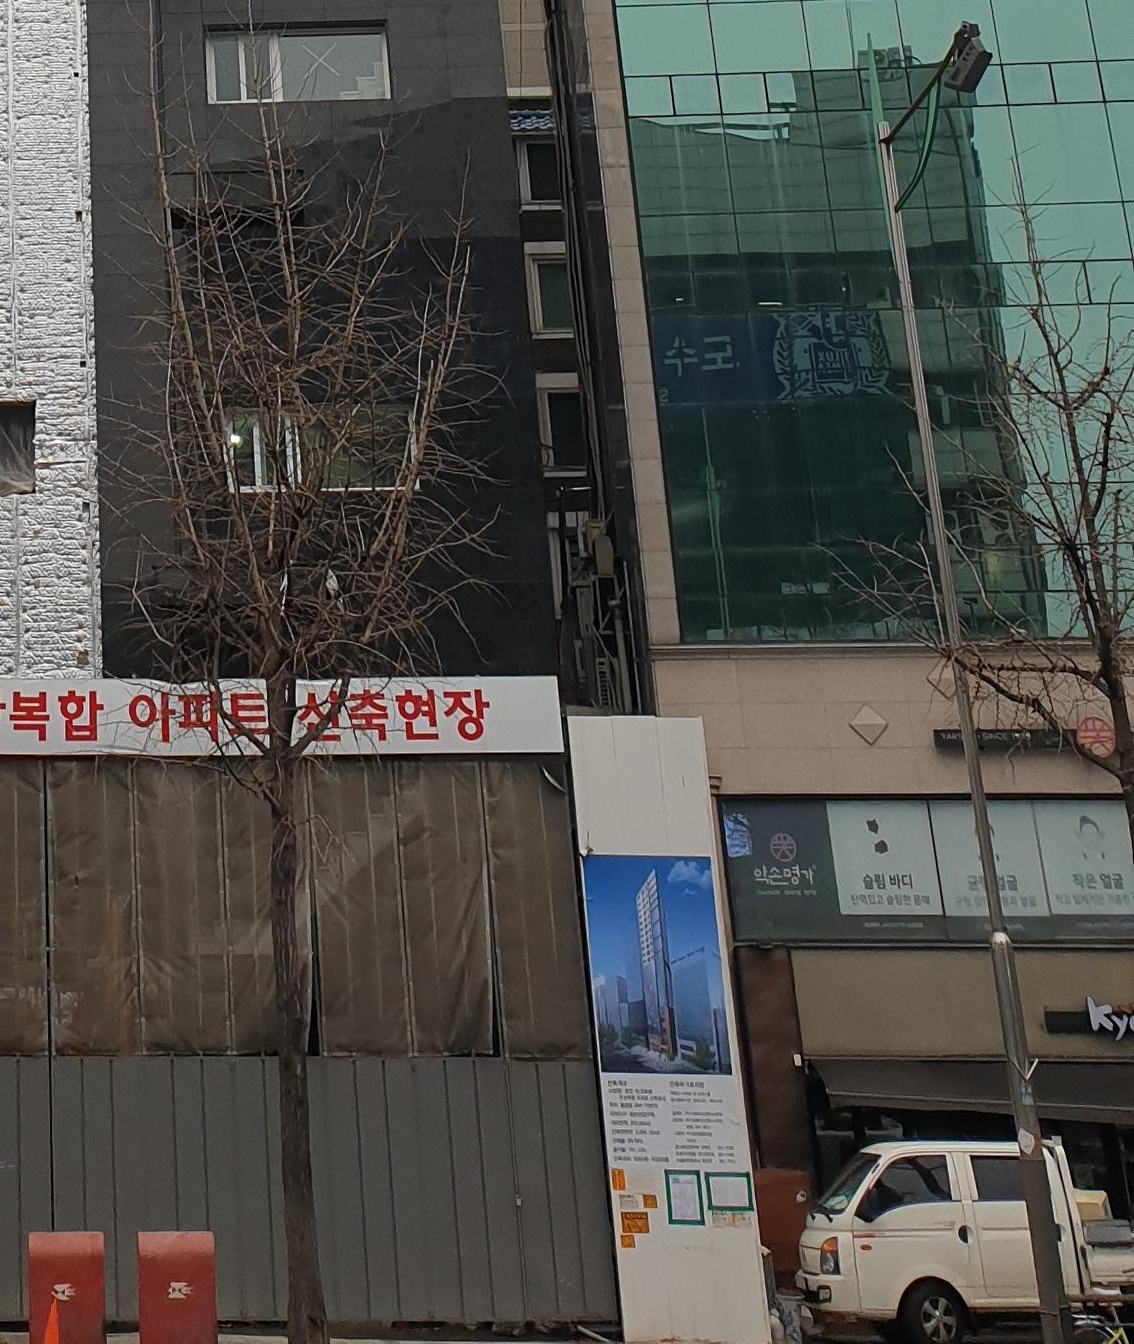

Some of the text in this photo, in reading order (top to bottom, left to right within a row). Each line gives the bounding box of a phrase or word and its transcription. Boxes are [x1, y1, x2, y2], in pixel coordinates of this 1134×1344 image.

[753, 864, 815, 886] 약손명가
[862, 873, 914, 890] 슬림 바디
